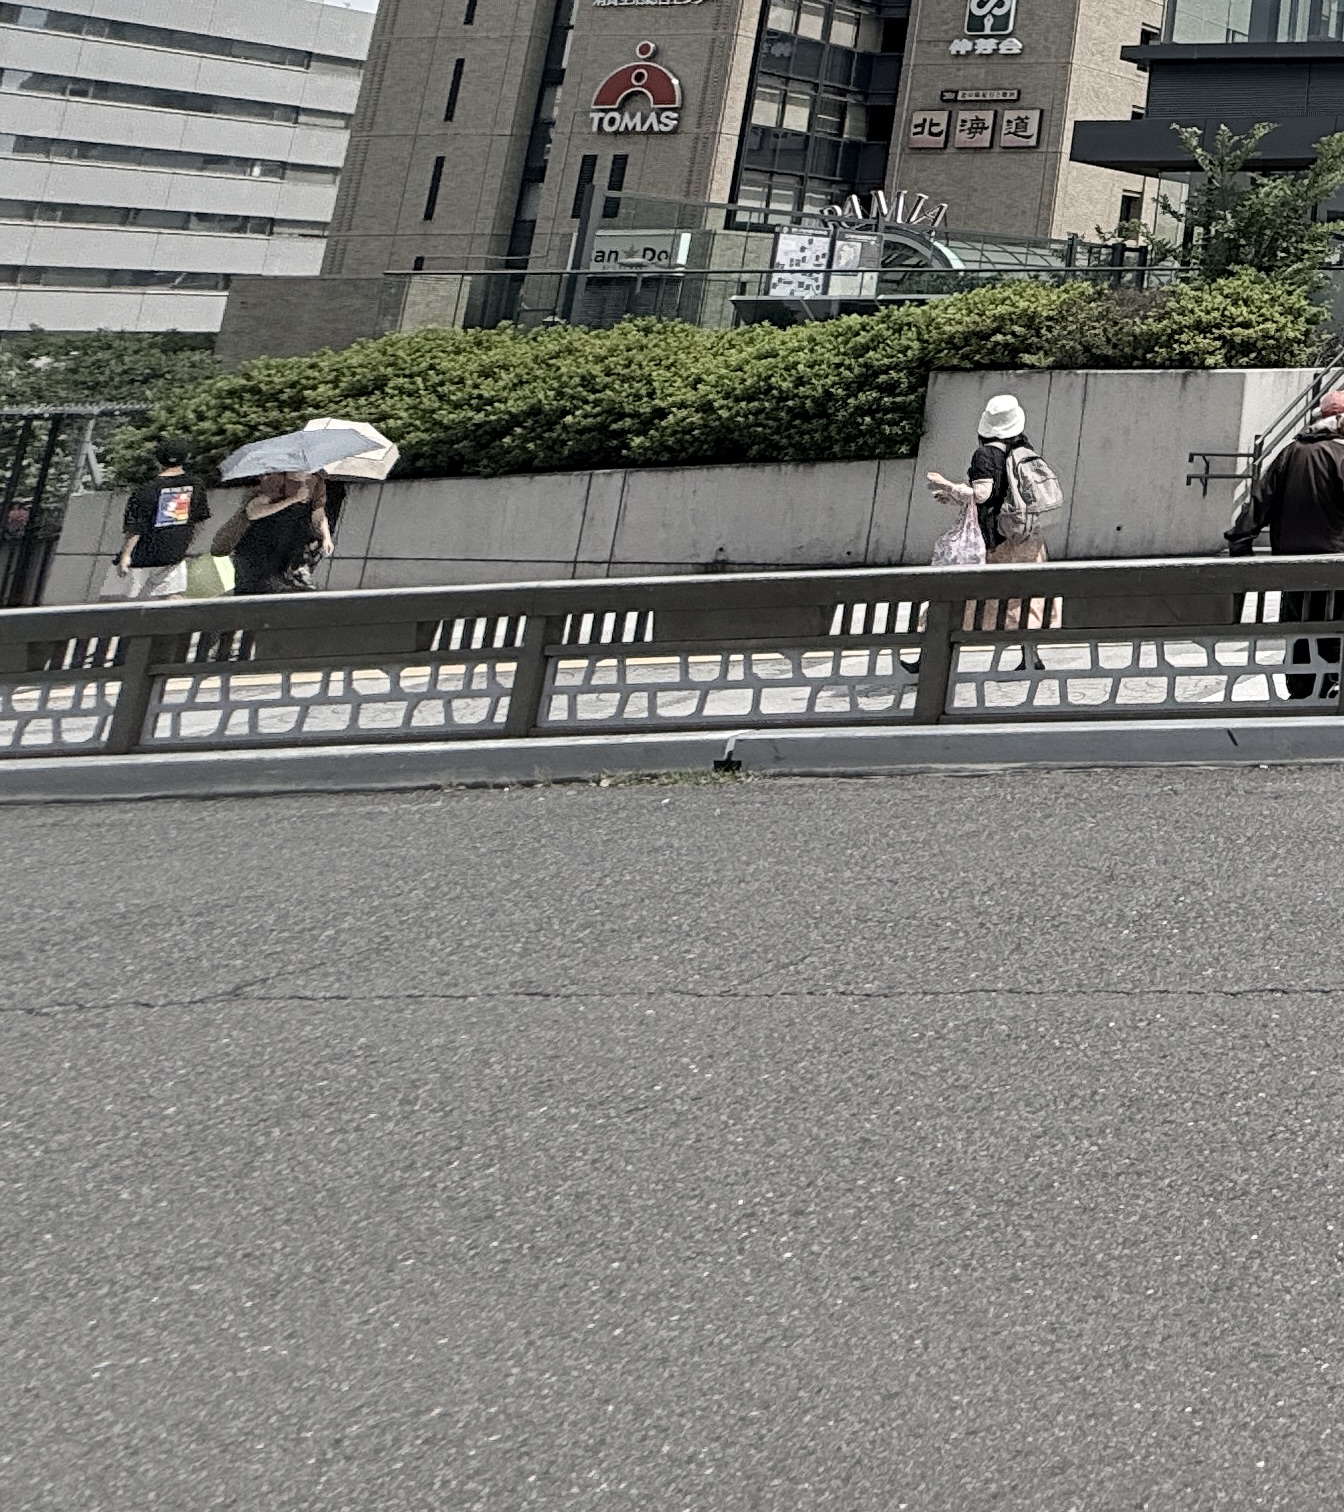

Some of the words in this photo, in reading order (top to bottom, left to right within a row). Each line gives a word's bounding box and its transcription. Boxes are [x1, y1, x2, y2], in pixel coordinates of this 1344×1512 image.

[589, 111, 679, 133] TOMAS
[912, 114, 1035, 140] 北海道
